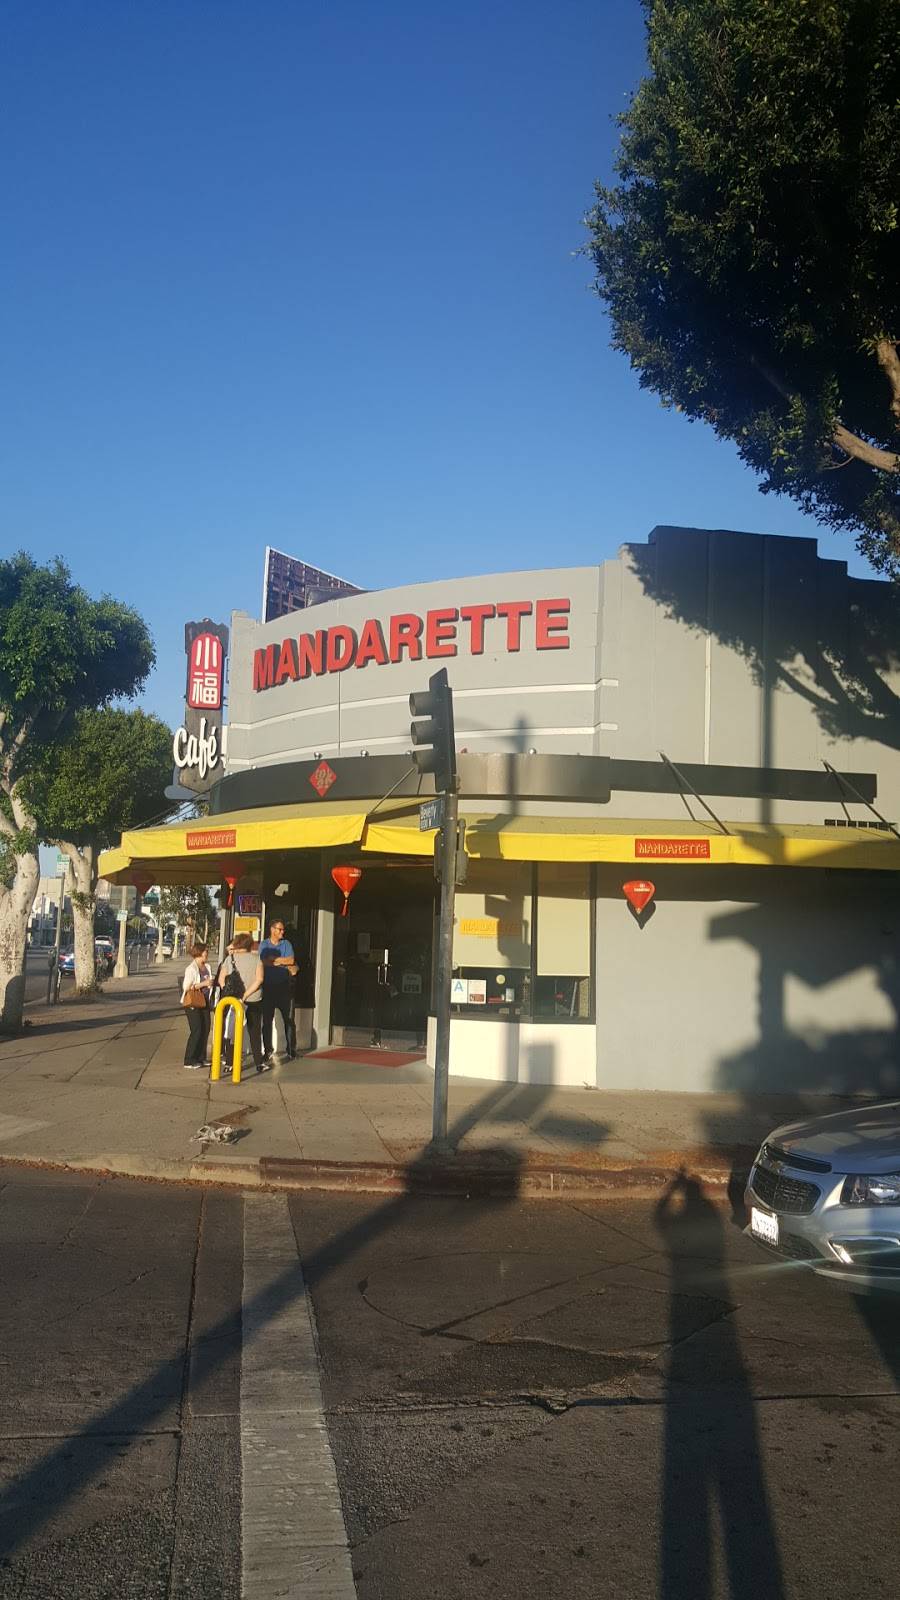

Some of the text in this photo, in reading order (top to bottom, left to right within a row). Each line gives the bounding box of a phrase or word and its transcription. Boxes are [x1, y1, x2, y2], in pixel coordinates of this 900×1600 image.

[252, 598, 570, 692] MANDARETTE
[192, 637, 218, 705] 小福
[173, 717, 218, 779] Café
[188, 832, 234, 847] MANDARETTE
[639, 842, 708, 855] MANDARETTE
[454, 980, 464, 992] A
